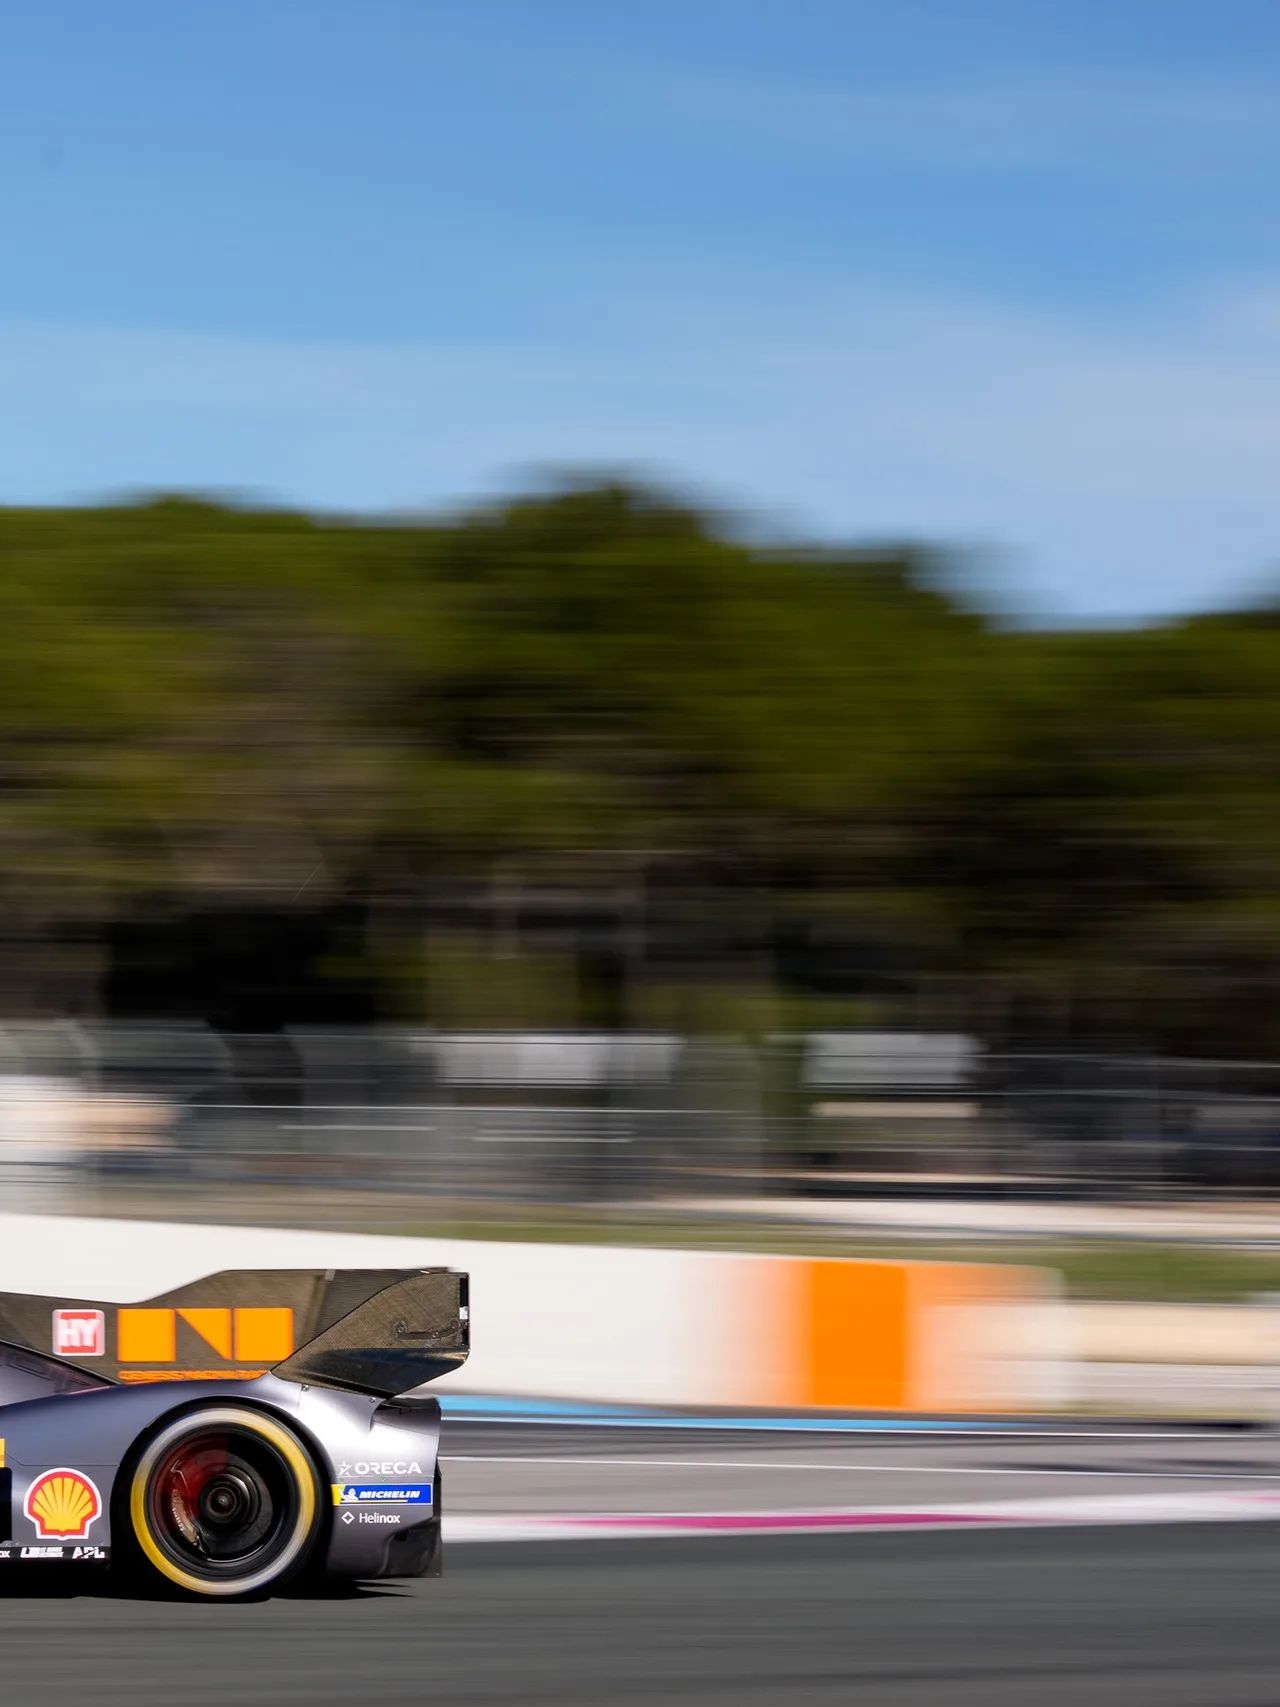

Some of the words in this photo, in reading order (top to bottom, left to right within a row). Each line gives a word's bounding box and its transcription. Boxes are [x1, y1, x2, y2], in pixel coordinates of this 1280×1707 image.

[354, 1461, 422, 1475] ORECA
[359, 1491, 420, 1499] MICHELIN
[359, 1512, 401, 1524] Helinox
